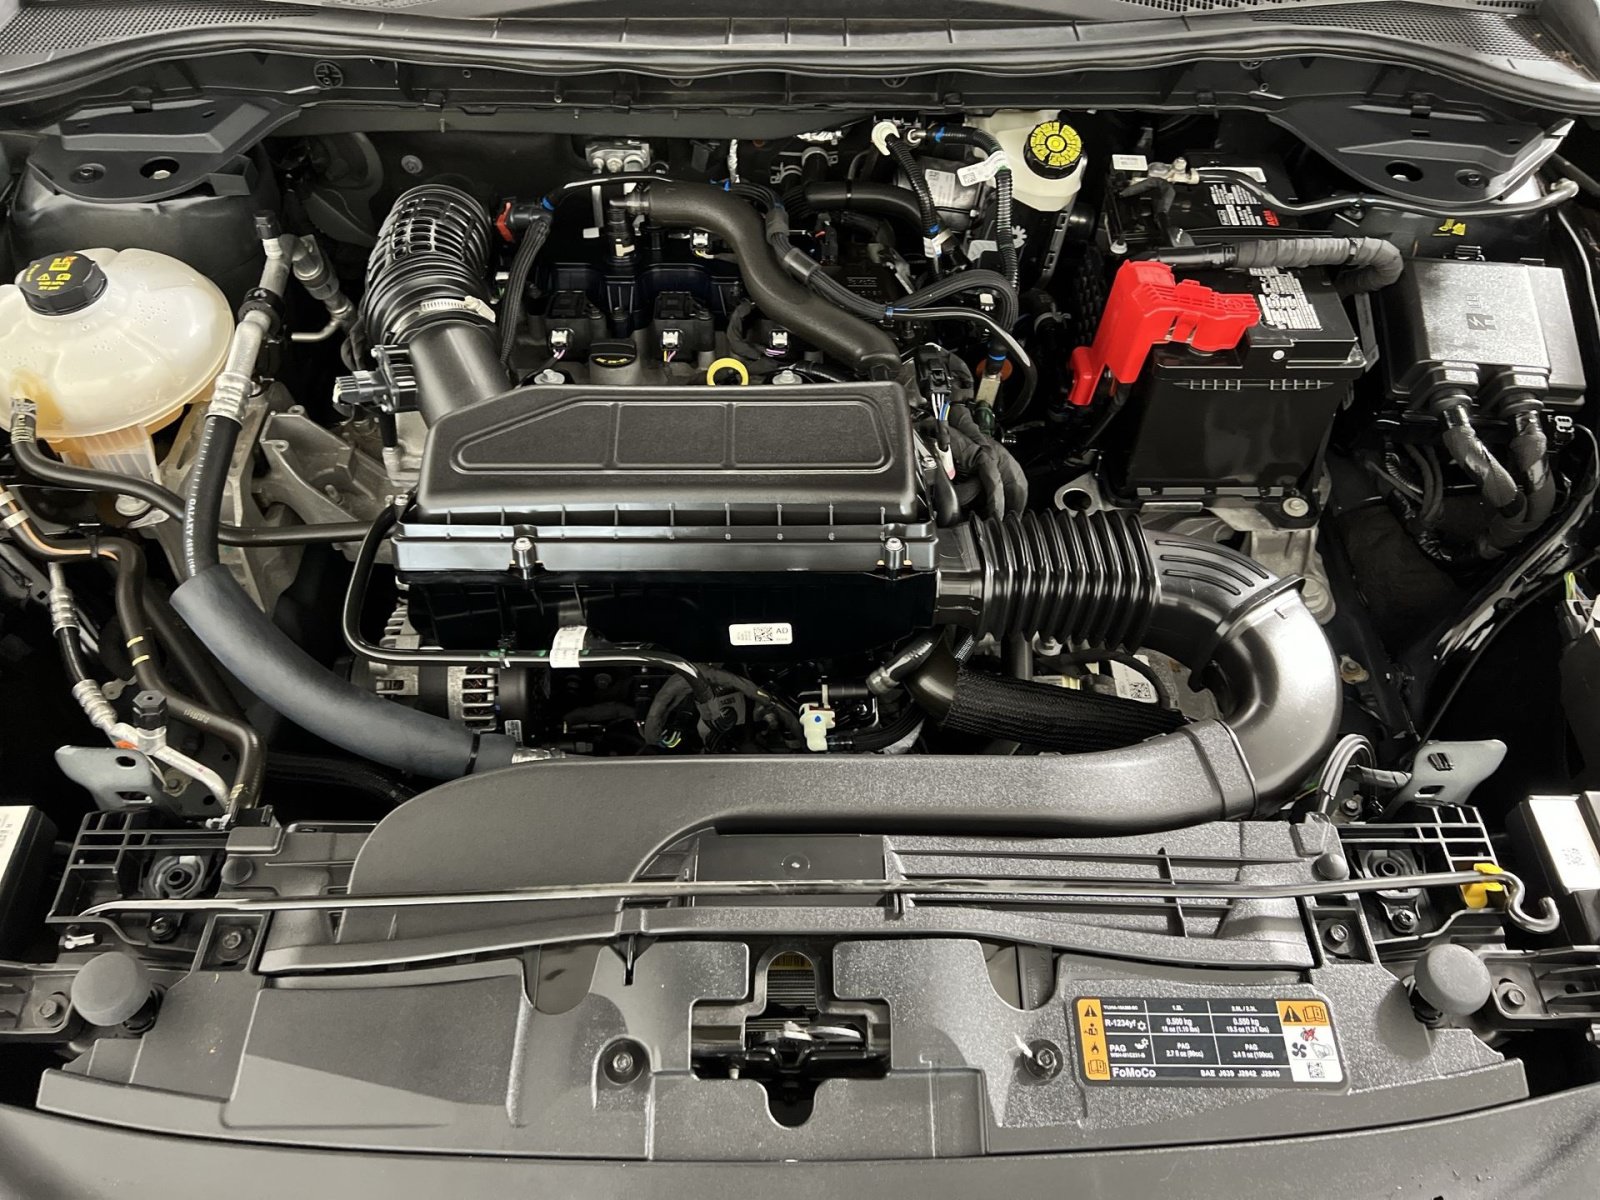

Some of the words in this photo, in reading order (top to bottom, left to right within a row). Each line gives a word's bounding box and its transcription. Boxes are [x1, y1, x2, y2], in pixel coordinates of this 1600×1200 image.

[1263, 209, 1278, 226] AGM
[186, 499, 196, 536] GALAXY
[1104, 1018, 1137, 1029] R-1234yf
[1166, 1017, 1183, 1025] 0.500
[1184, 1017, 1193, 1027] kg
[1250, 1018, 1260, 1027] kg
[1109, 1044, 1127, 1052] PAG
[1112, 1067, 1157, 1078] FoMoCo
